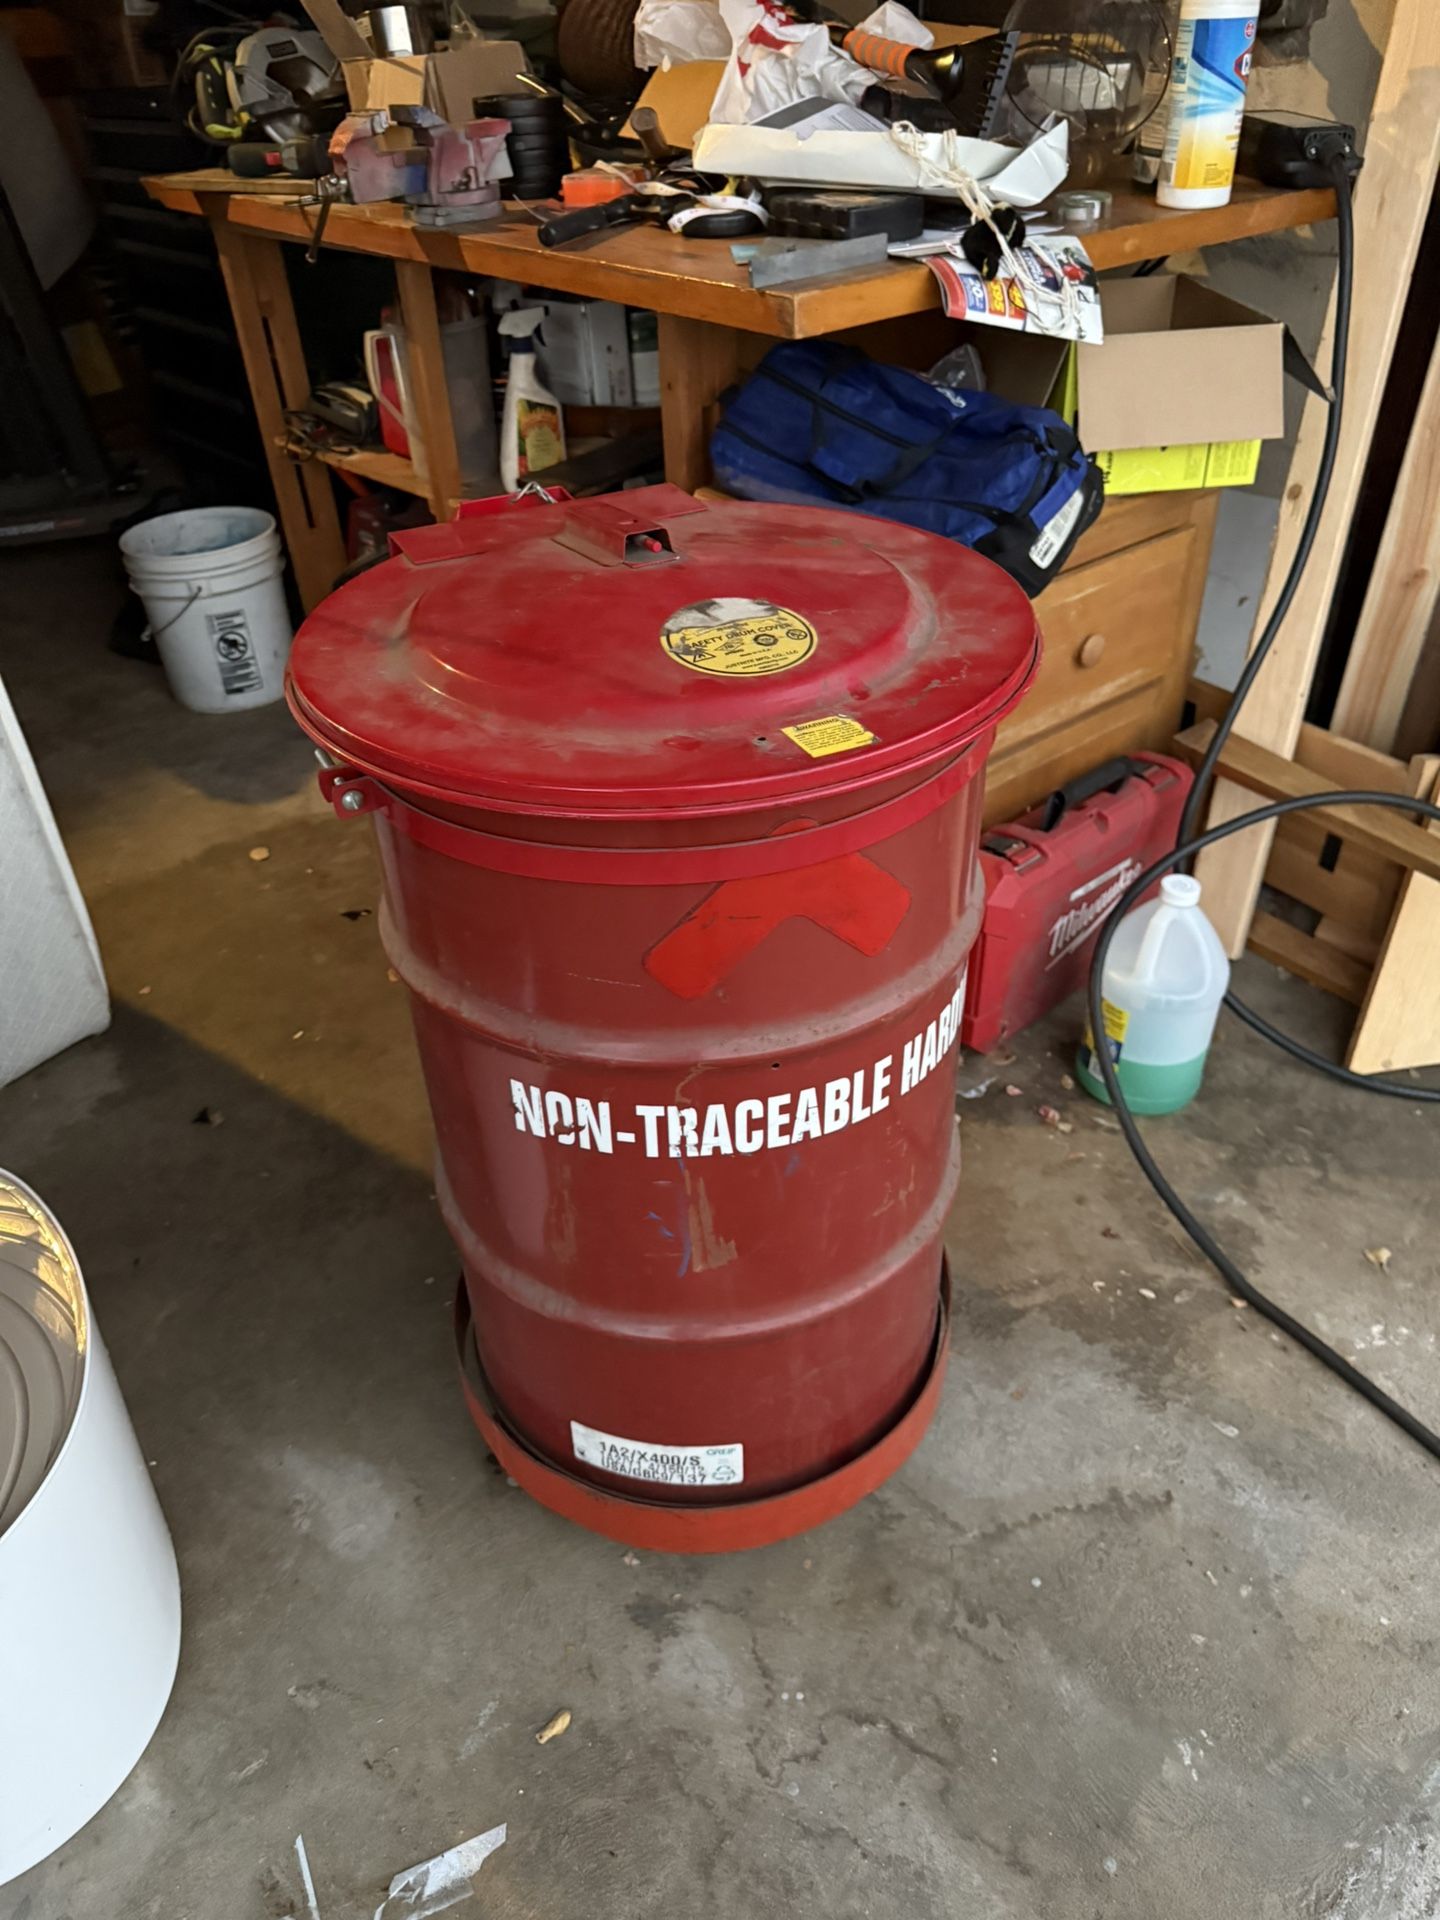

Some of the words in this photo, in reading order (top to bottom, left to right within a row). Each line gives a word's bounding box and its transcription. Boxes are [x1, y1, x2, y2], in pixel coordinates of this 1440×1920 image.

[725, 628, 757, 639] DRUM
[510, 1054, 893, 1158] NON-TRACEABLE
[600, 1442, 701, 1466] 1A2/X400/S
